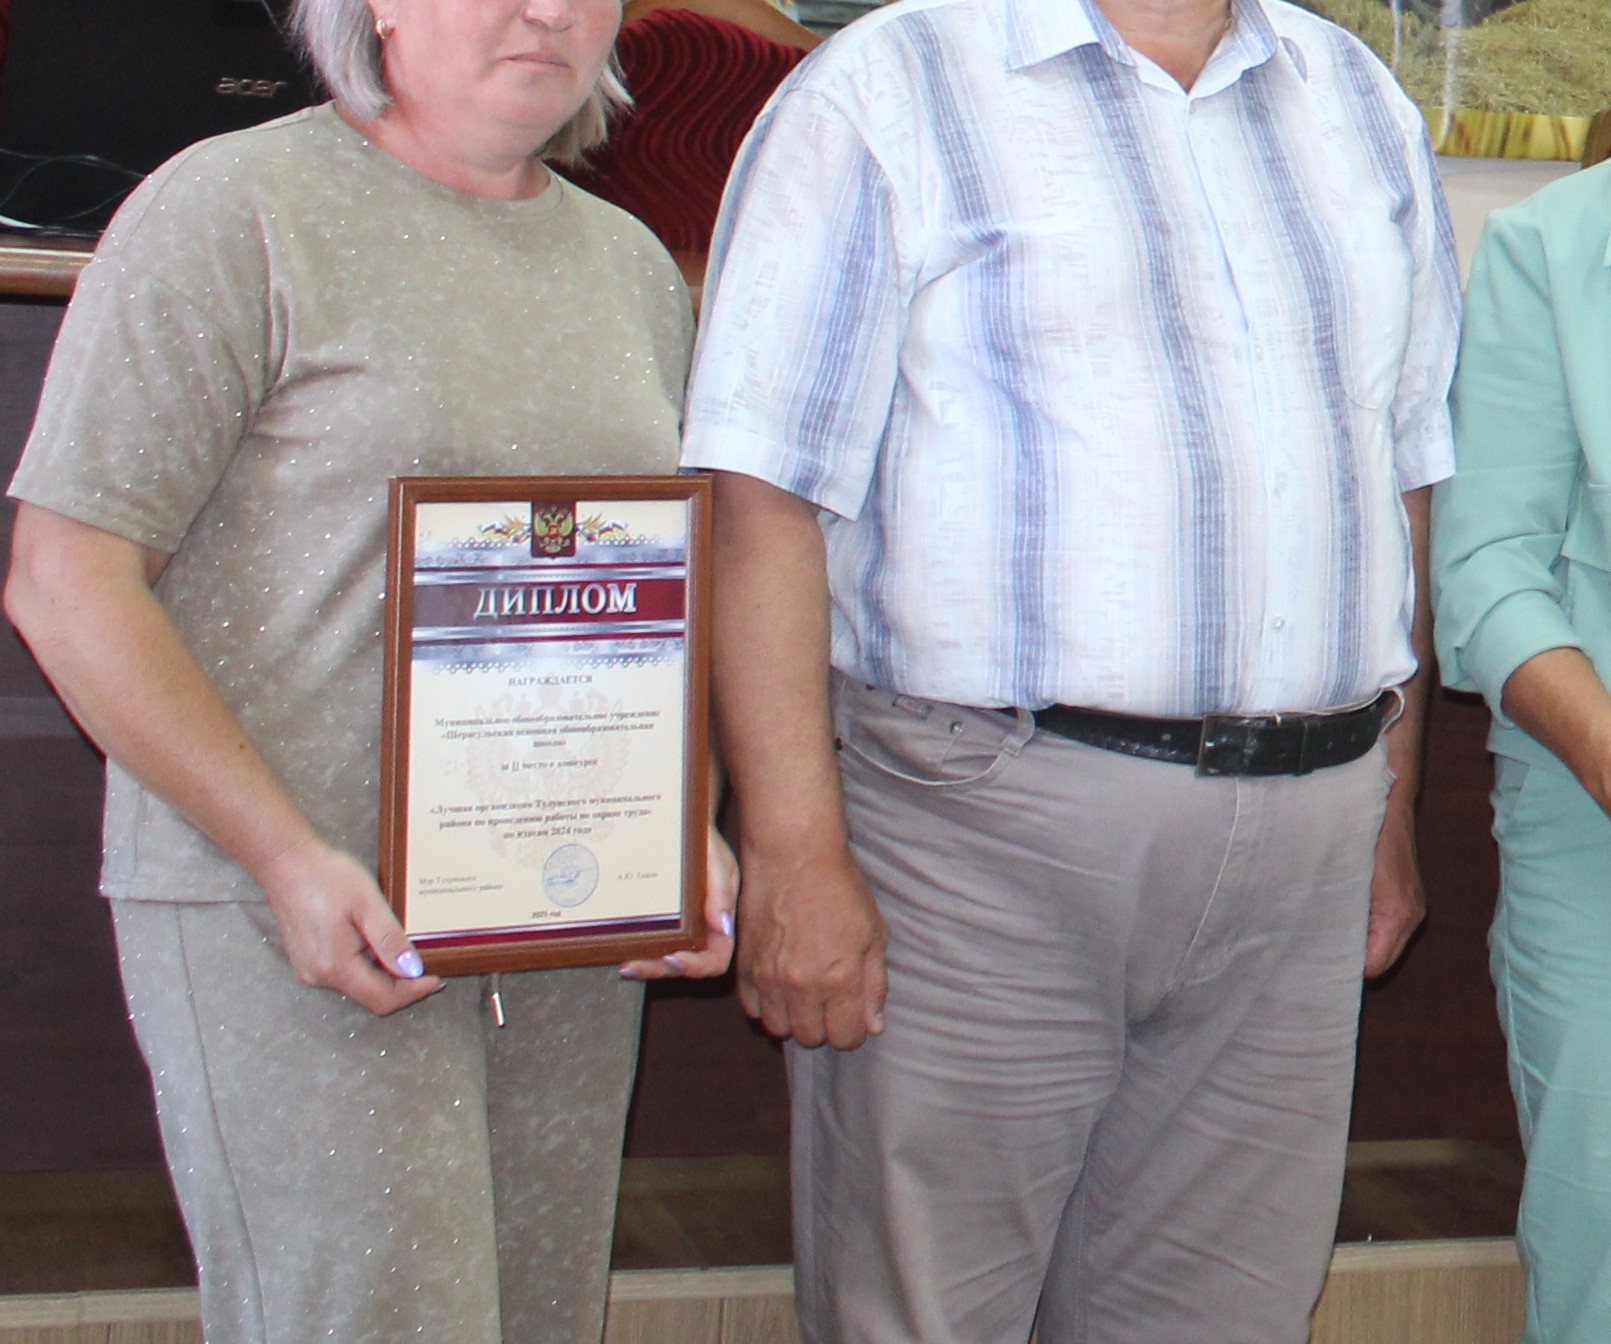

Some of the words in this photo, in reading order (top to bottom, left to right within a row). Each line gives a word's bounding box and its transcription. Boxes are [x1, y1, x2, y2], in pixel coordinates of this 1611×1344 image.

[215, 77, 288, 98] acer
[473, 582, 637, 619] ДИПЛОМ
[507, 675, 593, 687] НАГРАЖДАЕТСЯ
